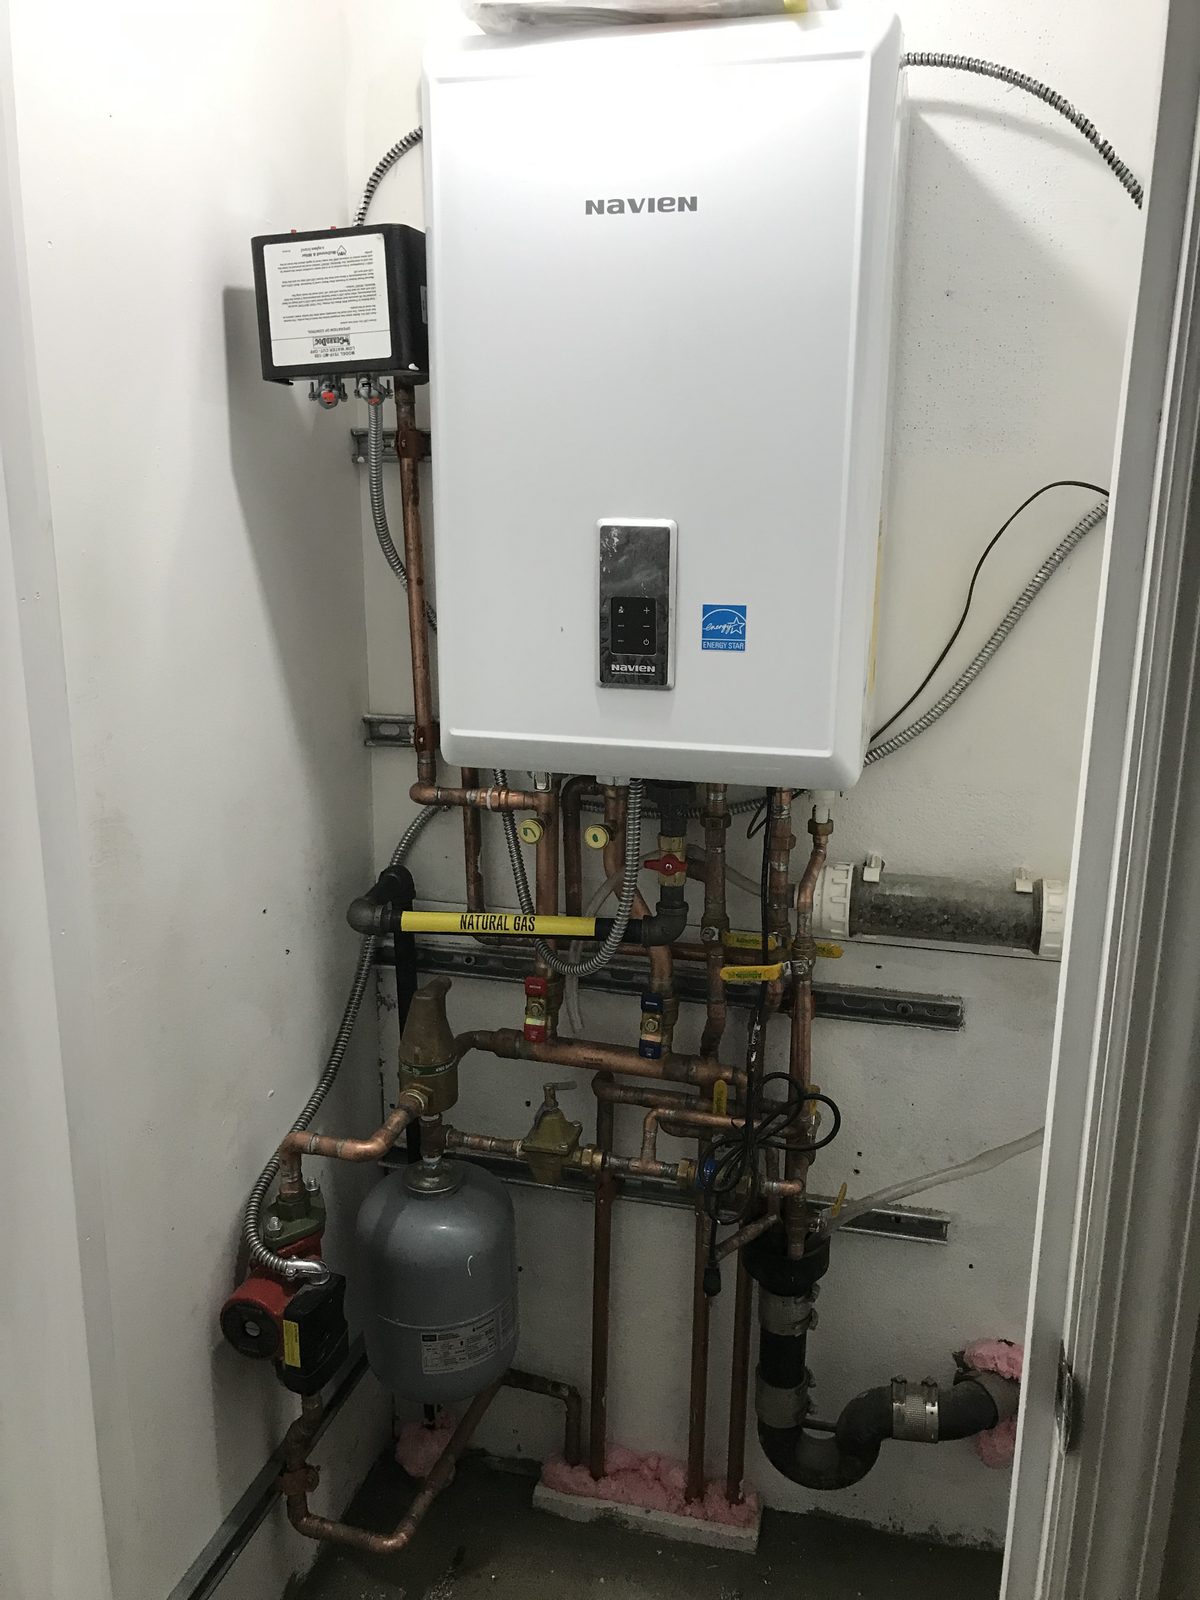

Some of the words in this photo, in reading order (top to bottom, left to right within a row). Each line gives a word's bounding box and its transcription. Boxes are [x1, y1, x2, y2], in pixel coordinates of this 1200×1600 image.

[702, 641, 727, 649] ENERGY
[728, 641, 745, 650] STAR
[460, 914, 509, 931] NATURAL
[513, 915, 536, 932] GAS
